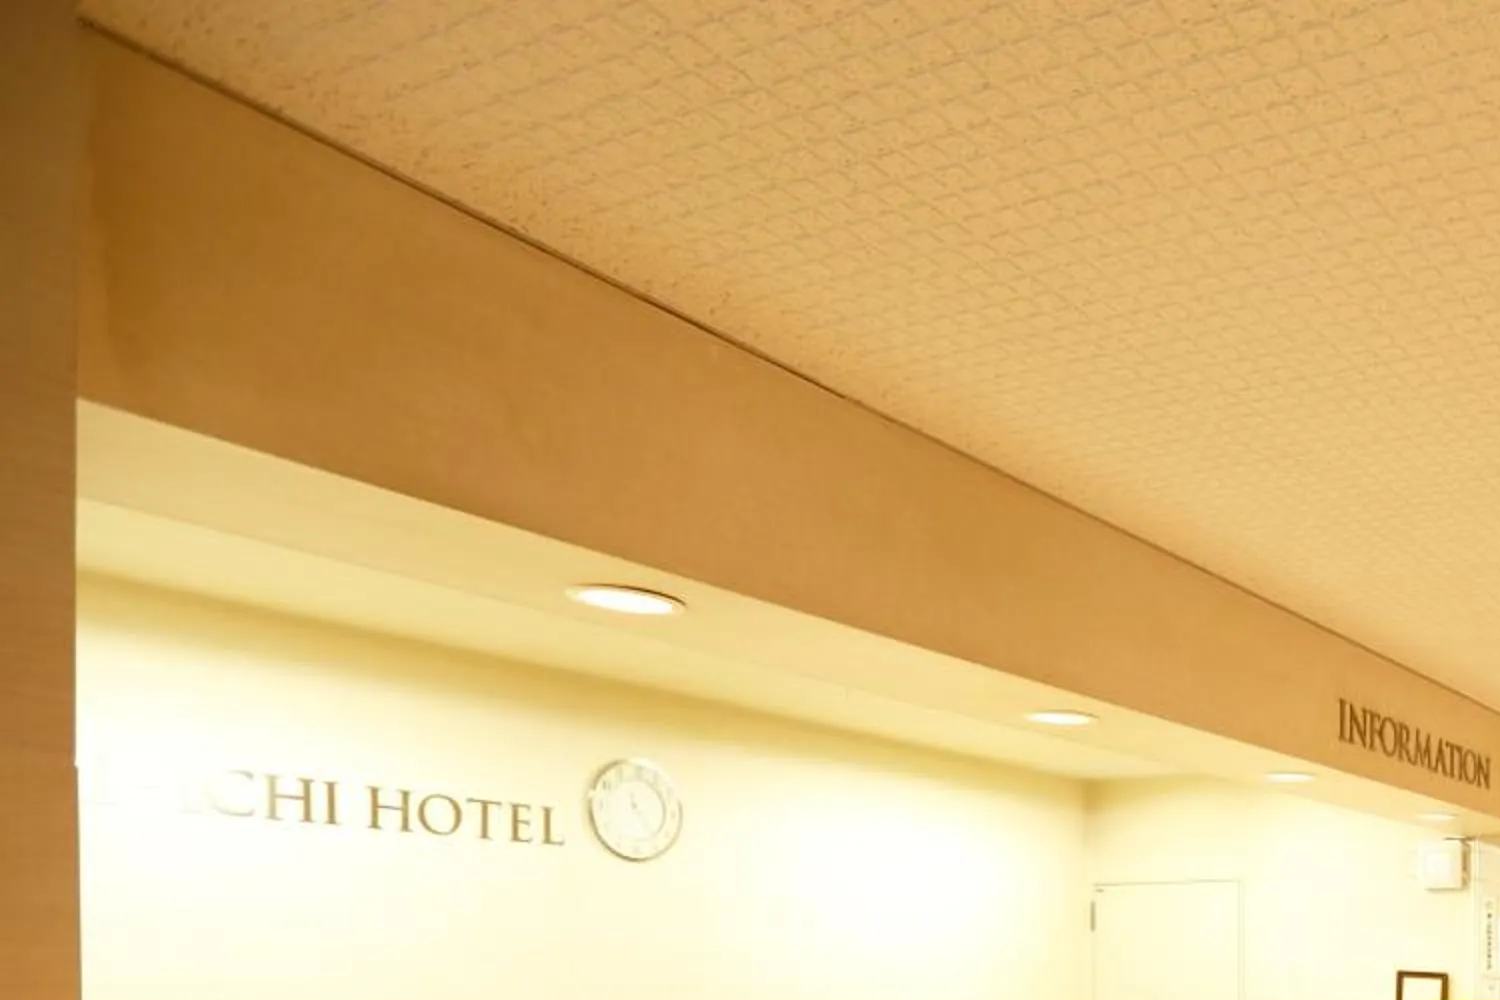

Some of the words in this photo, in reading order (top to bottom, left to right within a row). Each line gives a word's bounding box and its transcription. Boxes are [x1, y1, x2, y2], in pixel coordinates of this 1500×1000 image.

[1338, 697, 1492, 790] INFORMATION
[190, 769, 341, 826] CHI
[366, 785, 566, 847] HOTEL
